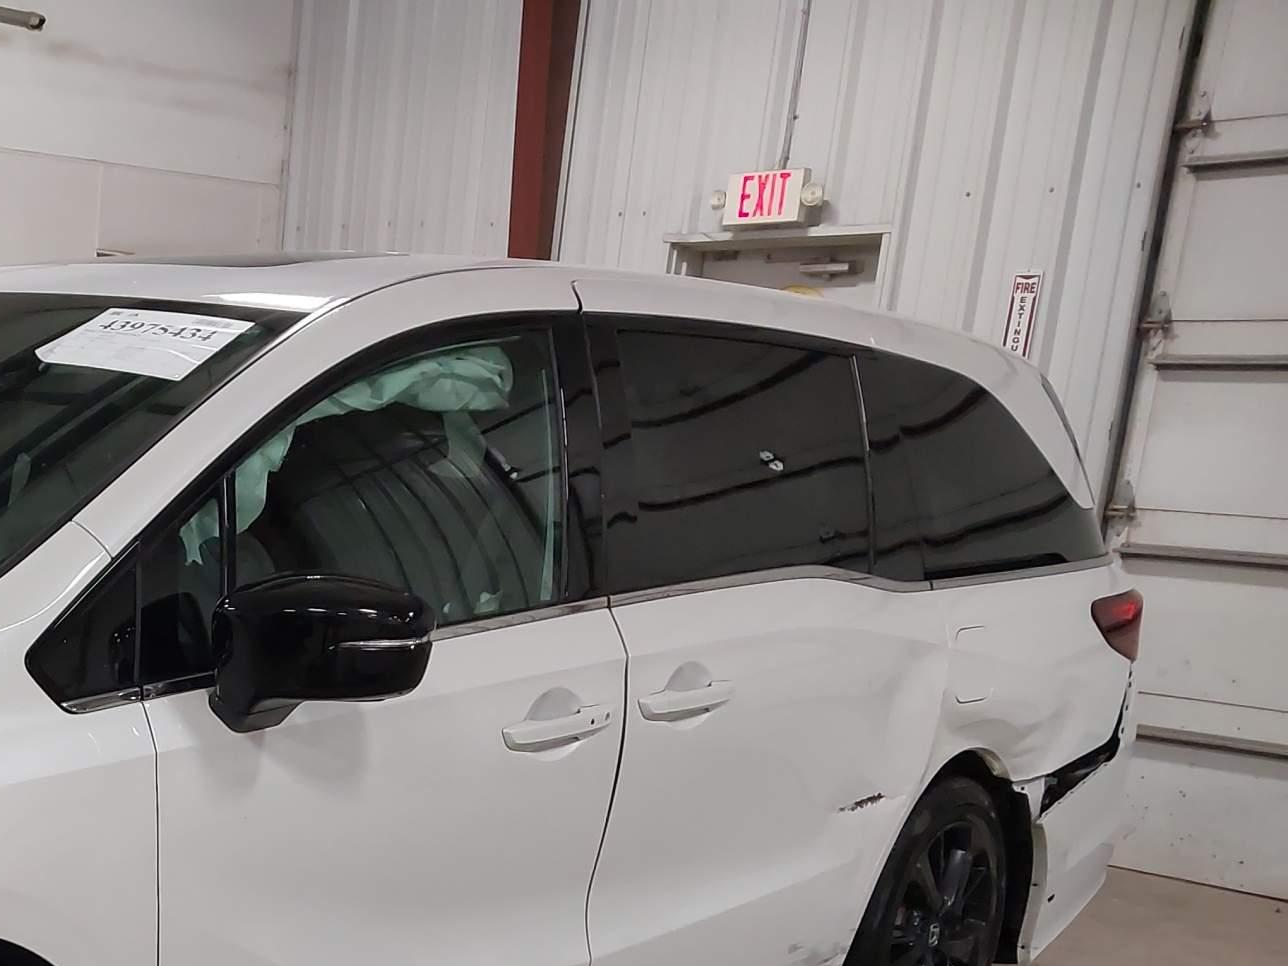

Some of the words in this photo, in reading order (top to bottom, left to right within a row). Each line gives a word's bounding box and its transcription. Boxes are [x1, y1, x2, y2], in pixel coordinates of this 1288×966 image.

[738, 172, 792, 218] EXIT
[1015, 282, 1037, 294] FIRE
[99, 319, 217, 342] 43975434
